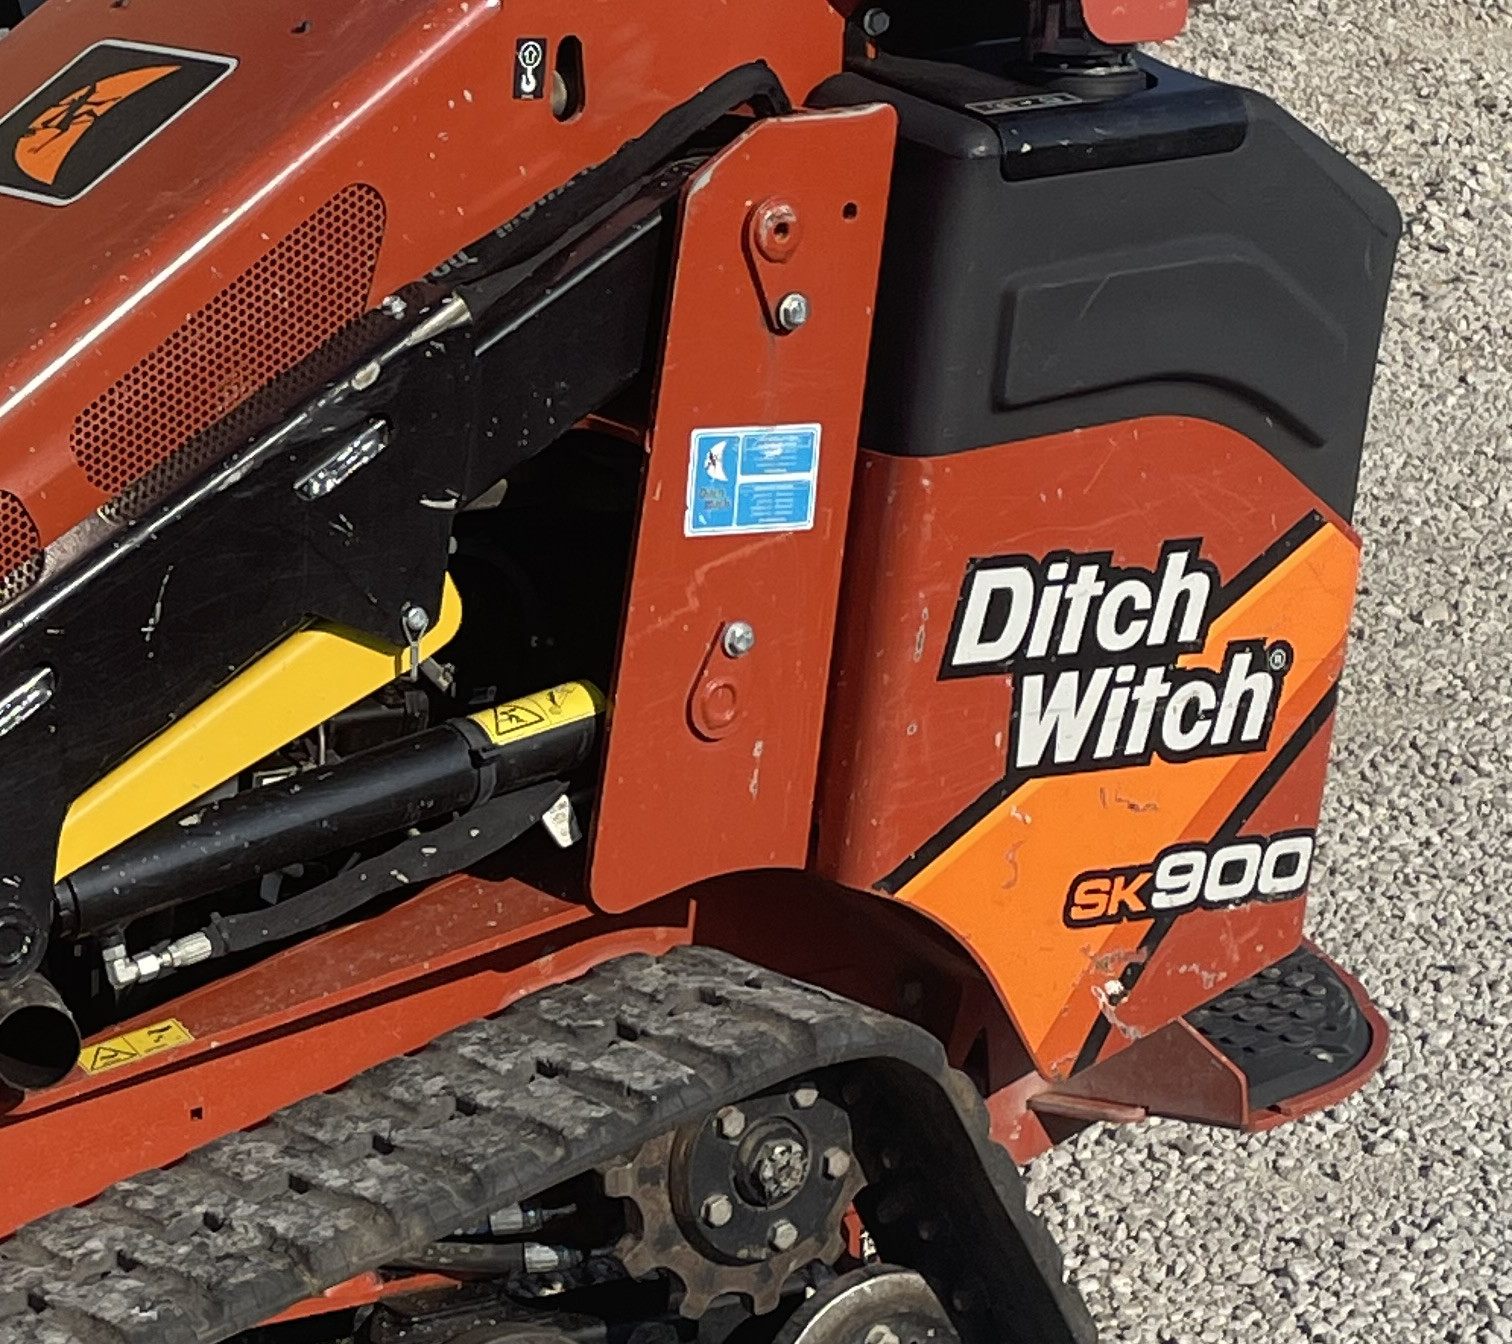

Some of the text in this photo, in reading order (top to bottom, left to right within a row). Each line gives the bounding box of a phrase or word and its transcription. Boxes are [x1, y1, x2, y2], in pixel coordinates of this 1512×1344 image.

[951, 550, 1212, 667] Ditch
[1015, 652, 1275, 769] Witch
[1069, 835, 1313, 920] SK900
